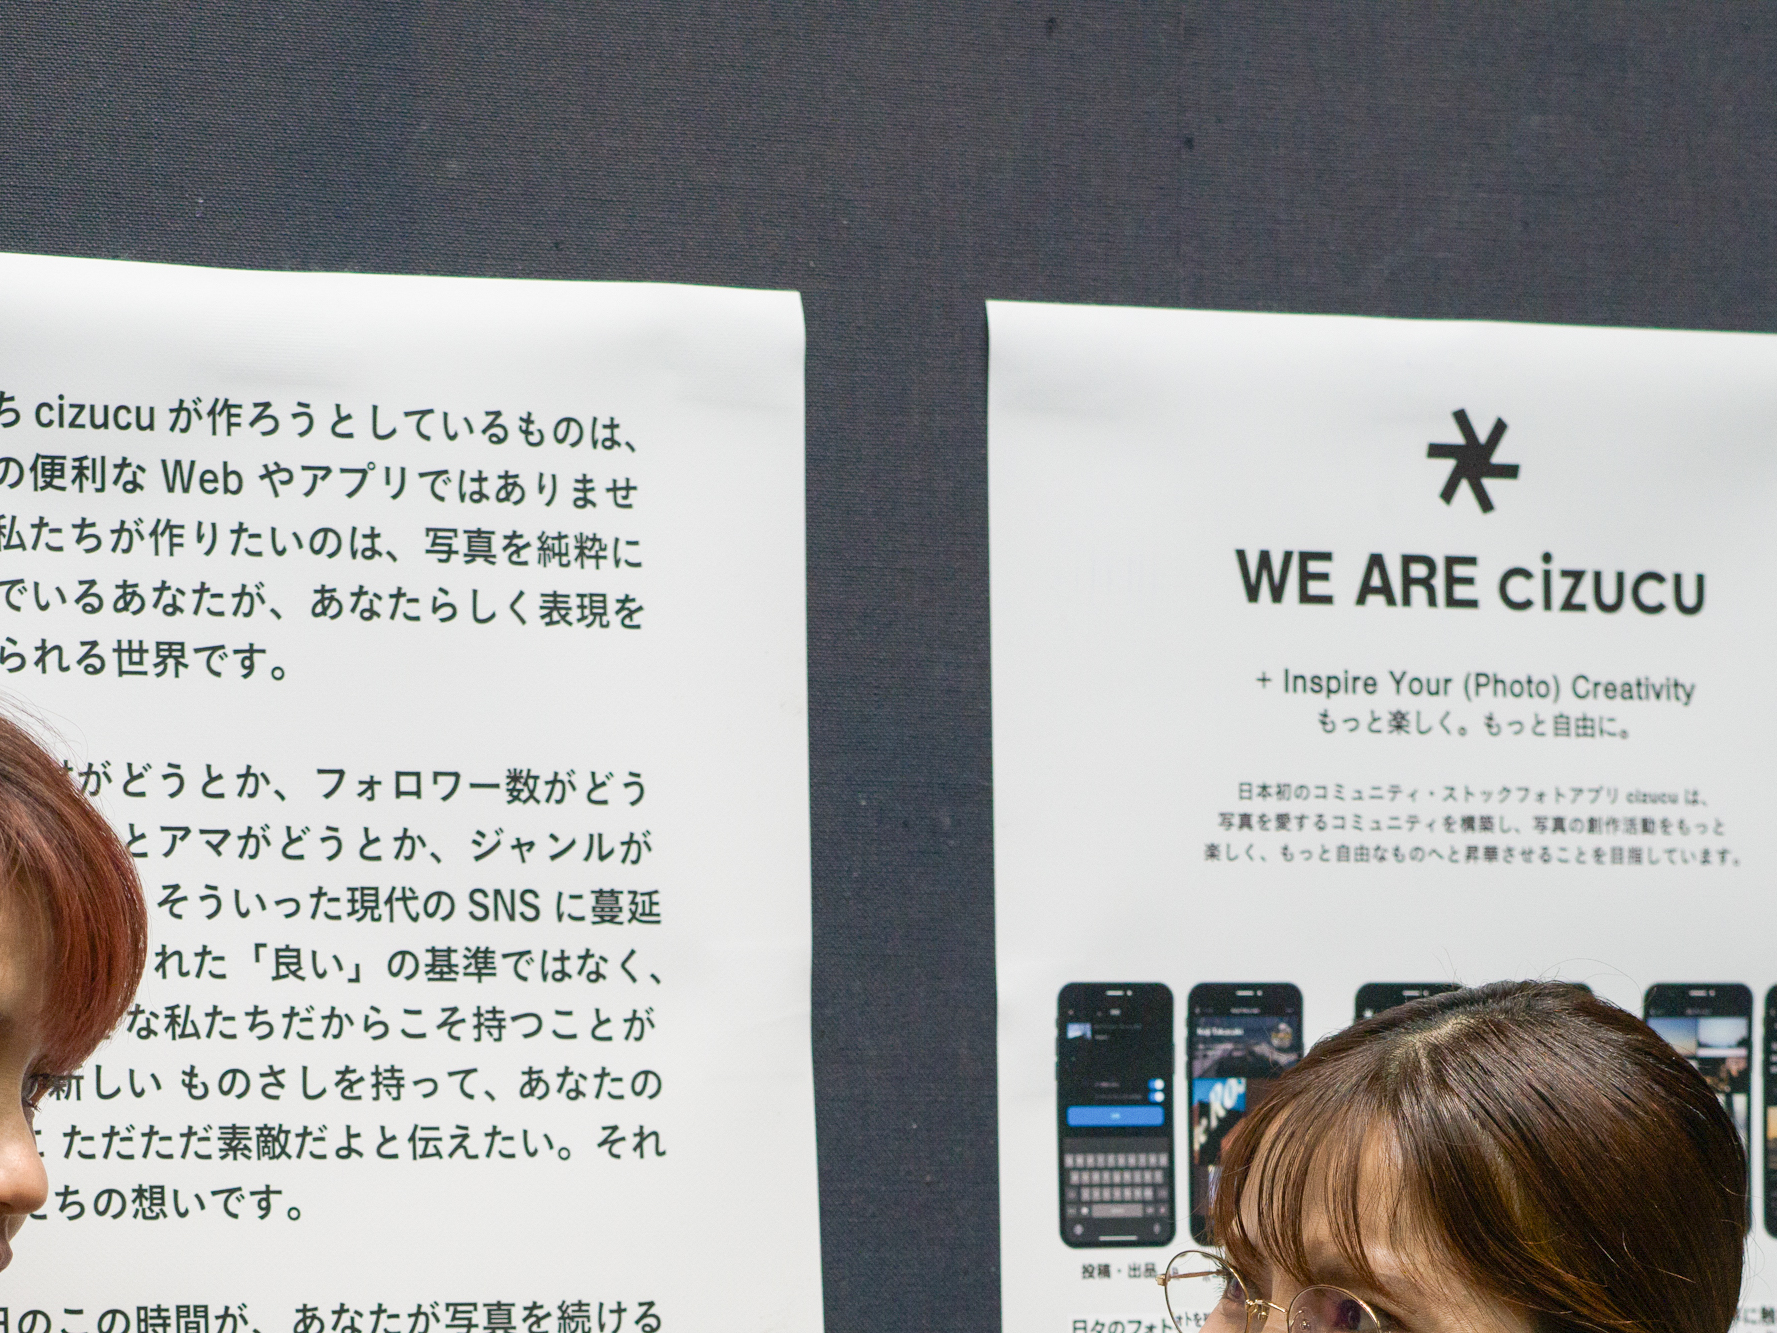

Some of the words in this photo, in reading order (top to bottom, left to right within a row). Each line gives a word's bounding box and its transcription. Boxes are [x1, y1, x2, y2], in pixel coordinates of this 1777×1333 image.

[34, 393, 155, 432] cizucu
[168, 396, 636, 453] が作ろうとしているものは、
[160, 458, 244, 496] Web
[258, 460, 638, 510] やアプリではありませ
[1234, 548, 1334, 606] WE
[1354, 552, 1480, 610] ARE
[1498, 551, 1706, 617] cizucu
[1284, 668, 1378, 699] Inspire
[1389, 670, 1453, 697] Your
[1464, 672, 1560, 701] (Photo)
[1572, 674, 1695, 706] Creativity
[1318, 709, 1628, 739] もっと楽しく。もっと自由に。
[1238, 782, 1616, 803] 日本初のコミュニティ・ストックフォトアプリ
[1625, 789, 1679, 806] cizucu
[156, 883, 456, 924] そういった現代の
[468, 887, 541, 923] SNS
[555, 887, 662, 926] に蔓延
[153, 942, 661, 985] れた「良い」の基準ではなく、
[180, 1064, 663, 1102] ものさしを持って、あなたの
[62, 1122, 667, 1162] ただただ素敵だよと伝えたい。それ
[1081, 1262, 1158, 1282] 投稿・出品
